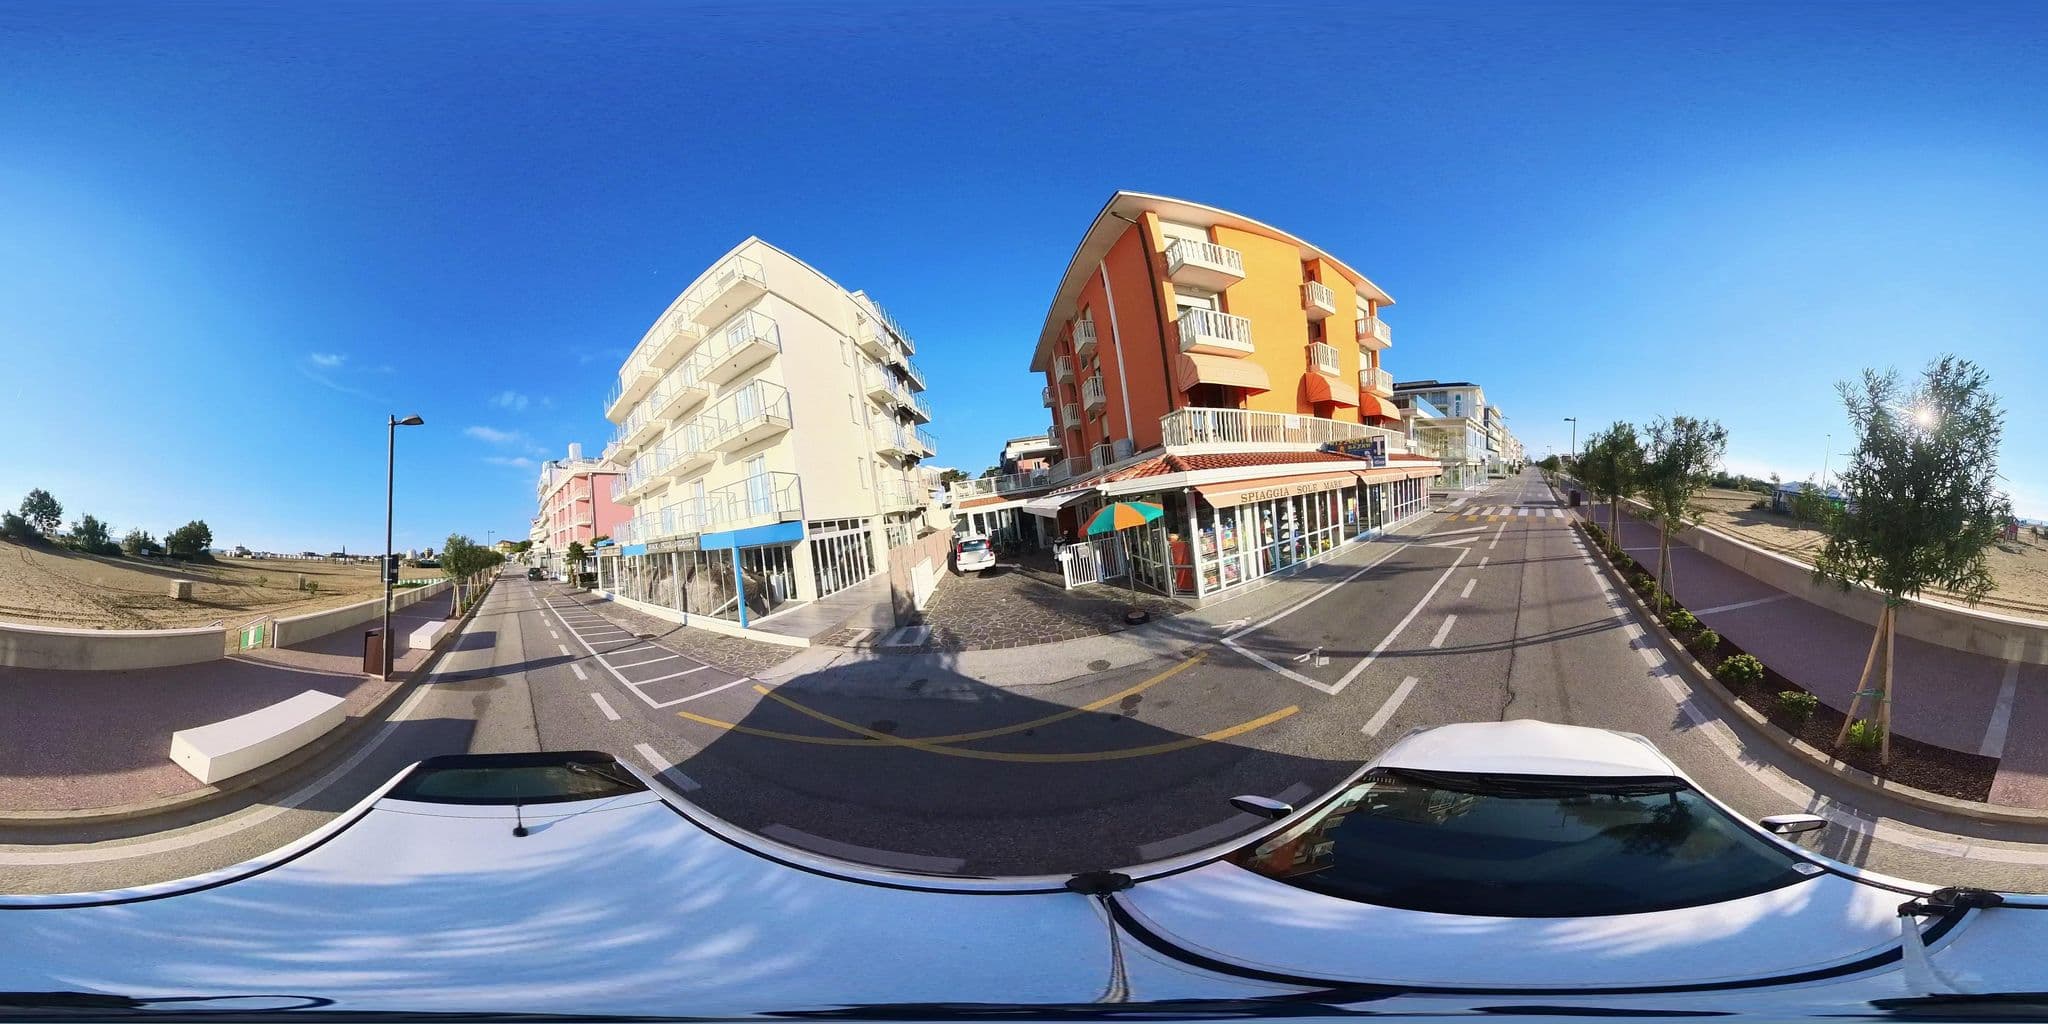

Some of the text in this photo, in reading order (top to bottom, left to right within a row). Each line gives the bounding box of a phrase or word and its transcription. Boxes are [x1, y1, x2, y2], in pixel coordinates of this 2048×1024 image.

[1240, 480, 1343, 503] SPIAGGIA SOLE MARE
